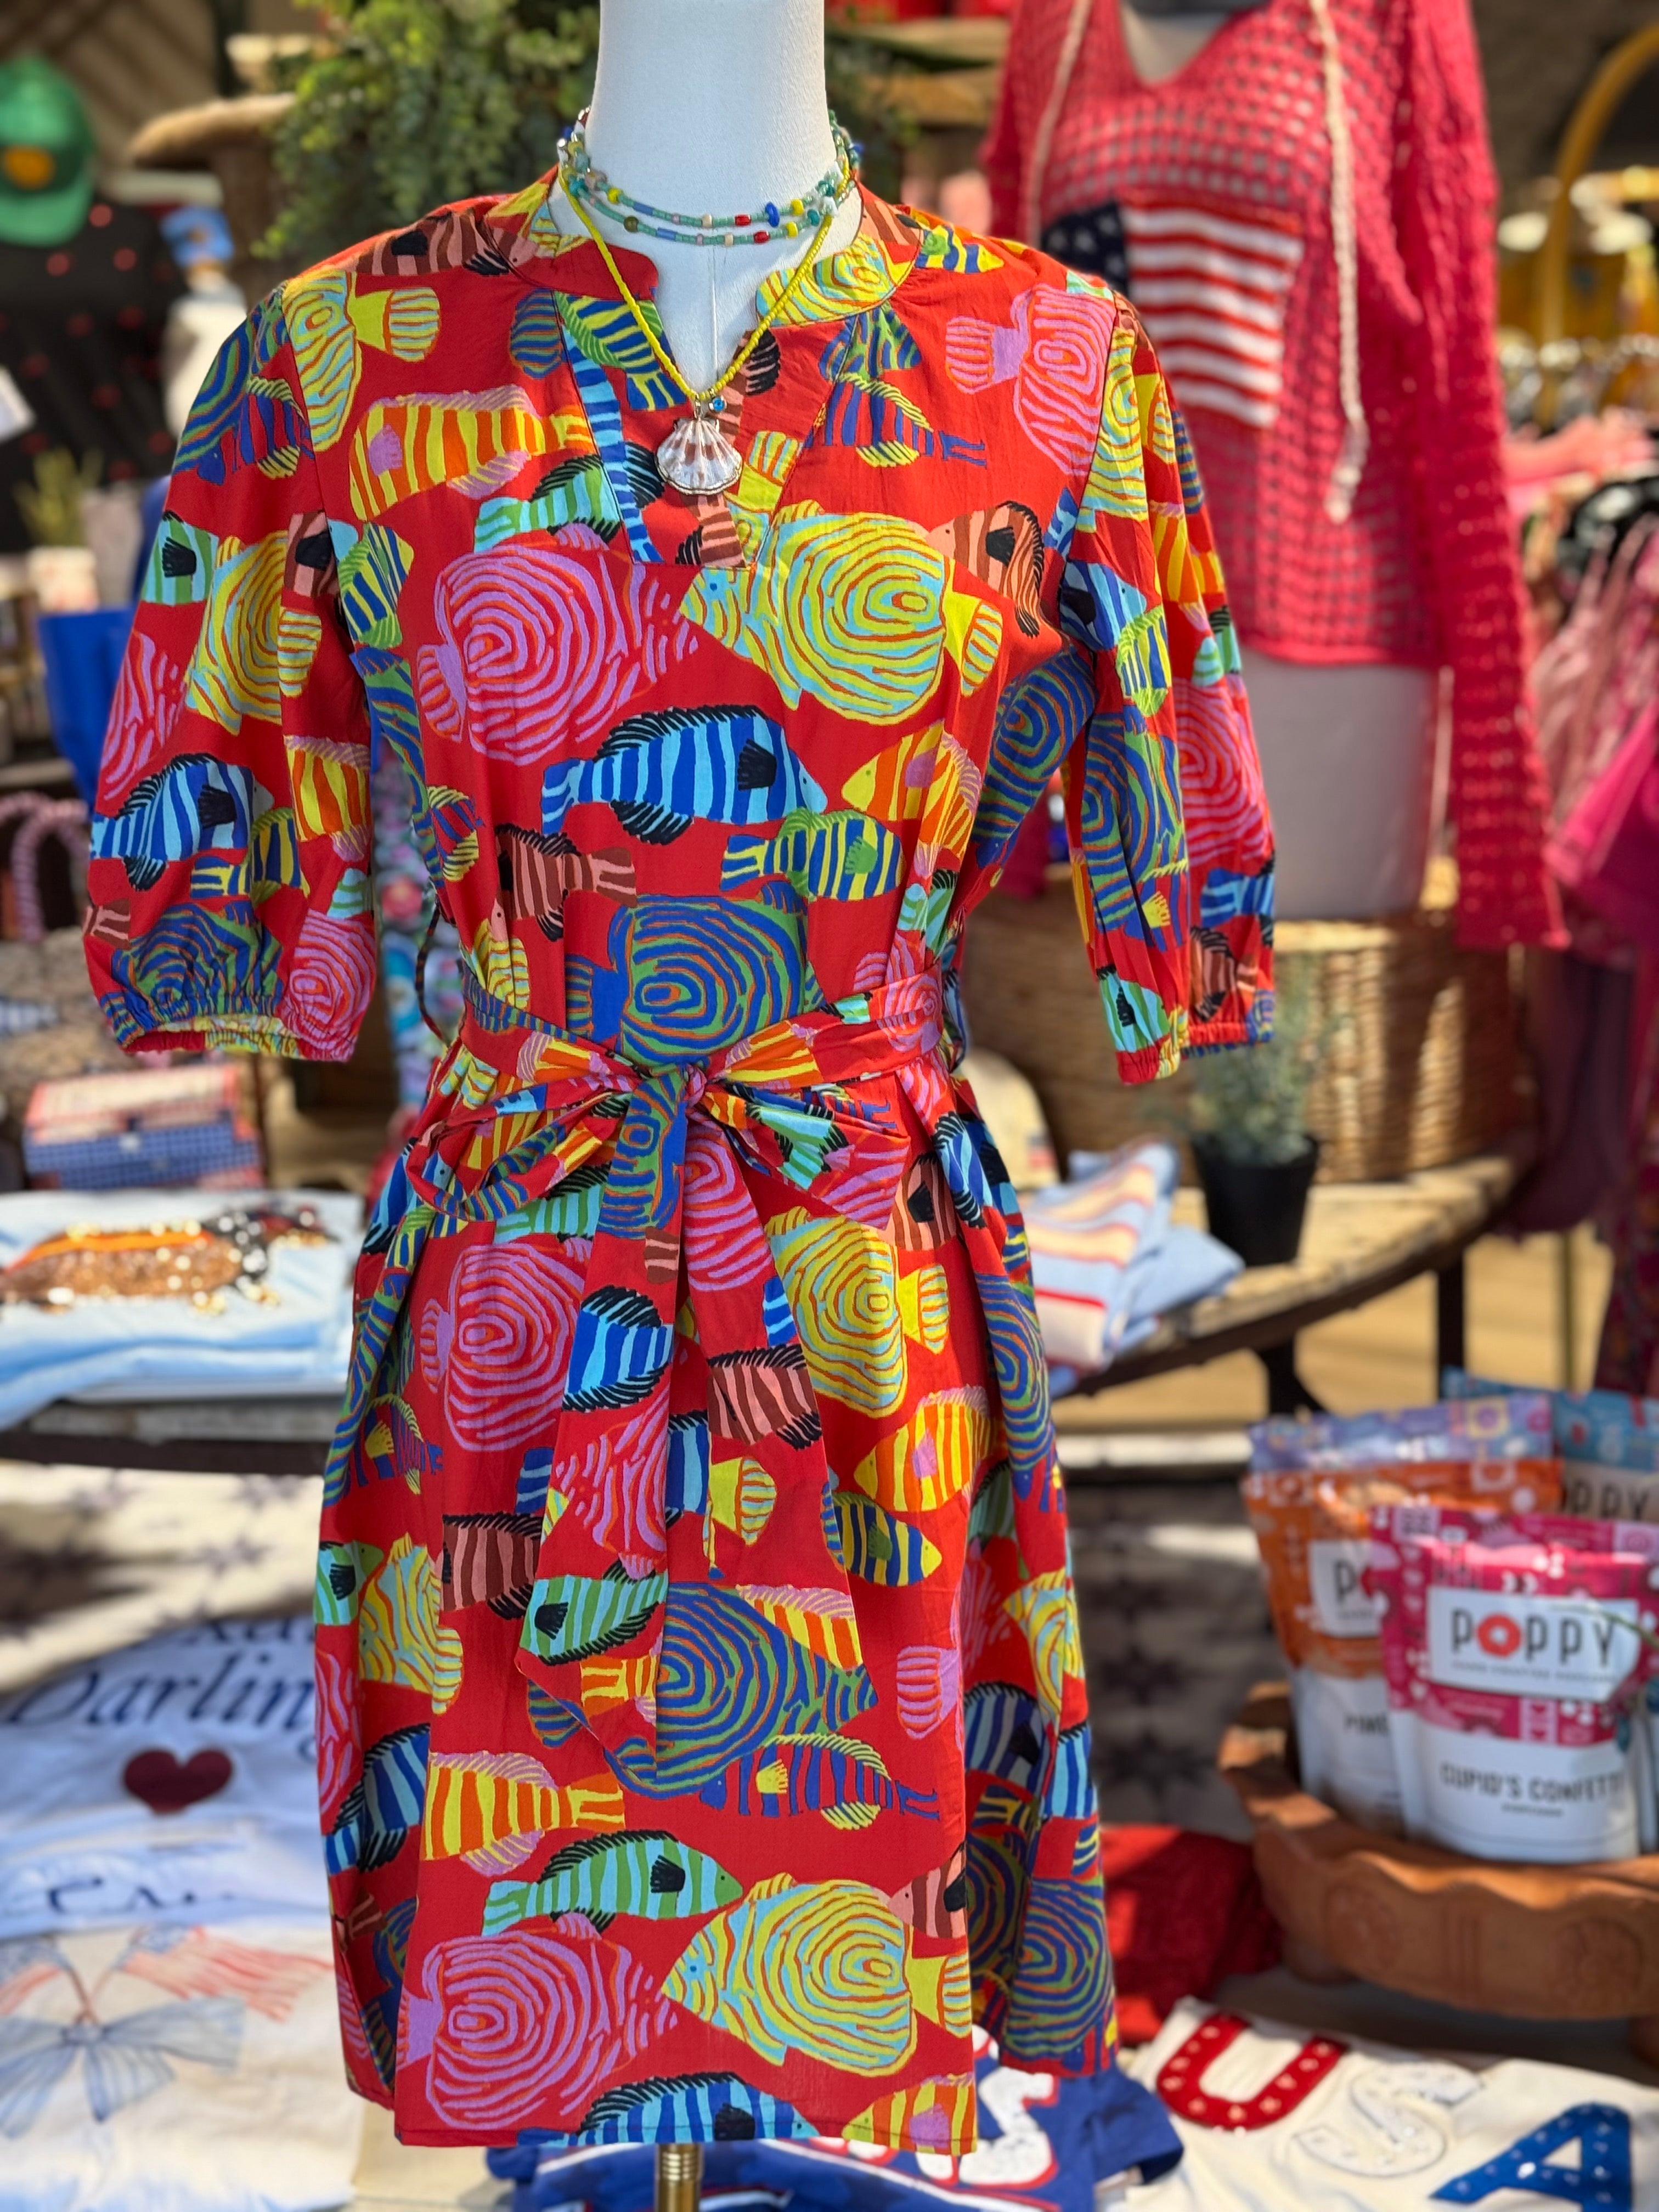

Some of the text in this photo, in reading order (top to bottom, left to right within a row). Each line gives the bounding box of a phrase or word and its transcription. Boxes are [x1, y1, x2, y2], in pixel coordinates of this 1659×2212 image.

[1560, 1477, 1649, 1522] PPY
[1451, 1608, 1616, 1666] POPPY
[4, 1649, 315, 1762] Darlin
[1441, 1762, 1522, 1799] CUPID'S
[1156, 2010, 1633, 2212] USA
